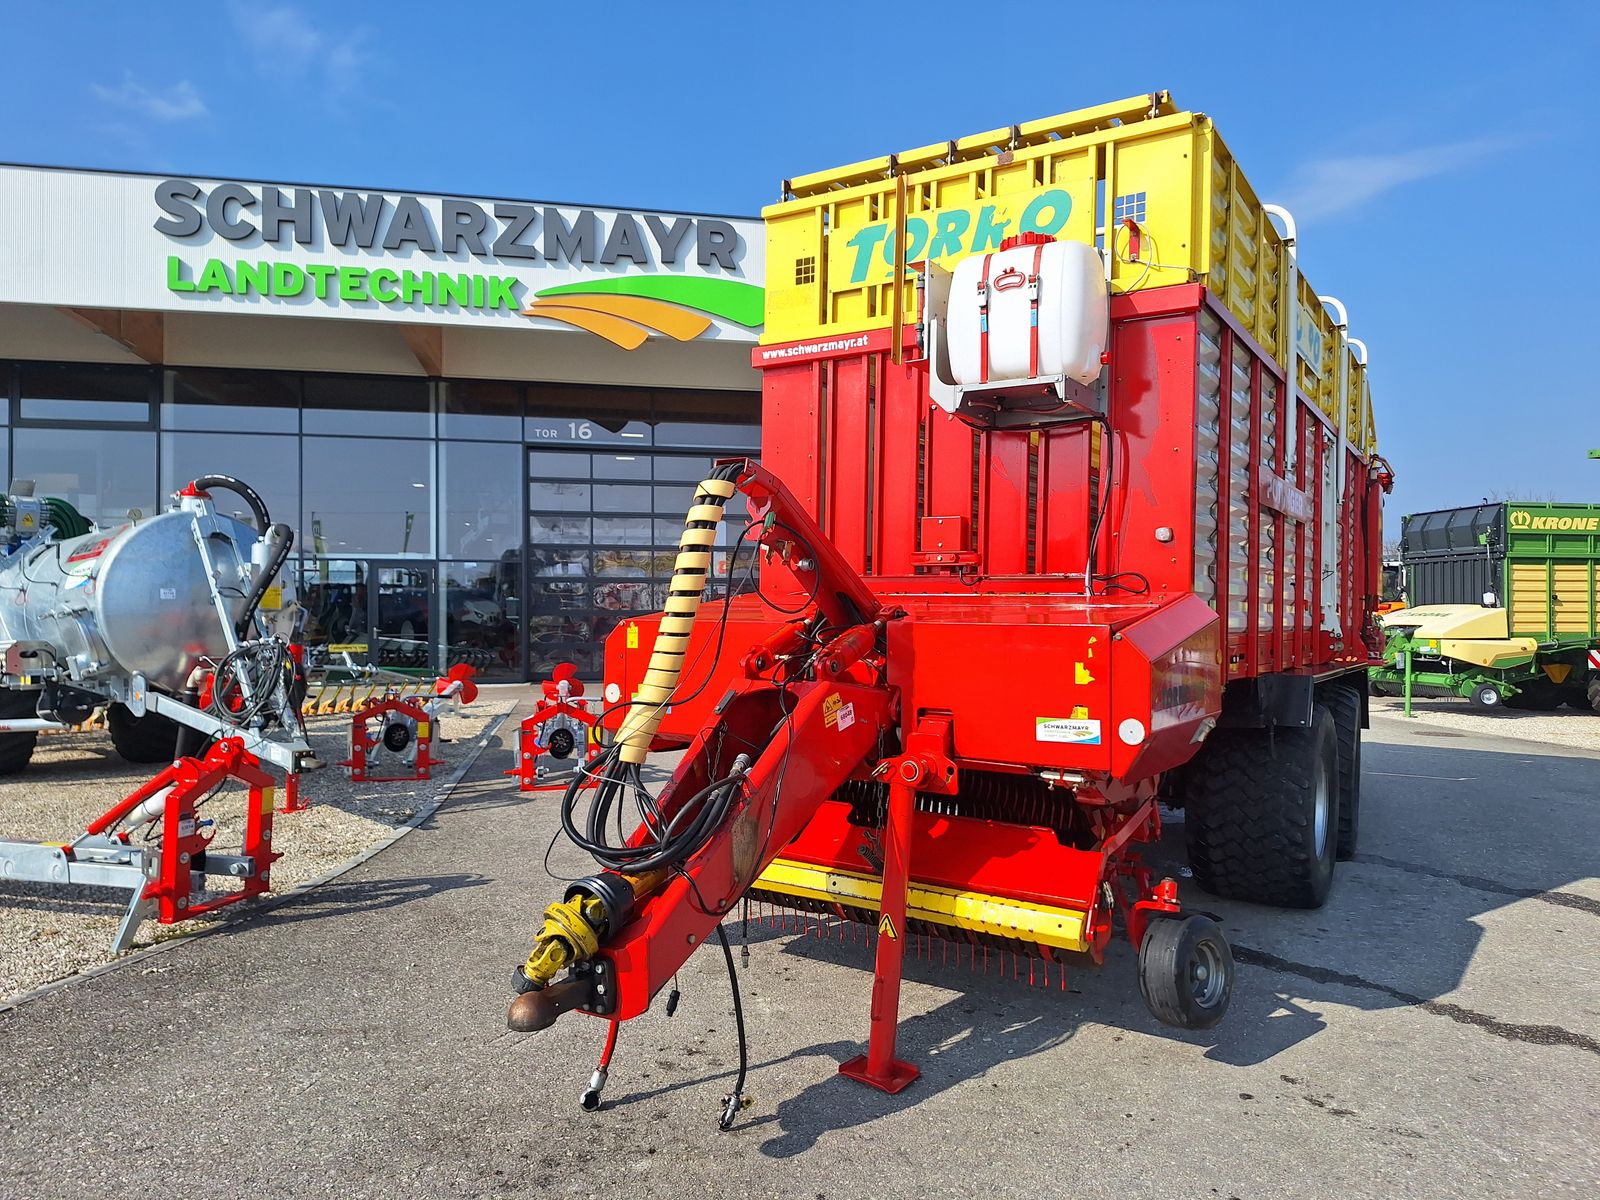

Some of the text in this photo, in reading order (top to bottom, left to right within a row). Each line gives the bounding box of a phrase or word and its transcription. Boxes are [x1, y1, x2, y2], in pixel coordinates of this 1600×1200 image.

[153, 179, 739, 269] SCHWARZMAYR
[167, 255, 520, 310] LANDTECHNIK
[762, 334, 869, 360] www.schwarzmayr.at
[535, 422, 593, 440] TOR 16
[1531, 516, 1600, 531] KRONE
